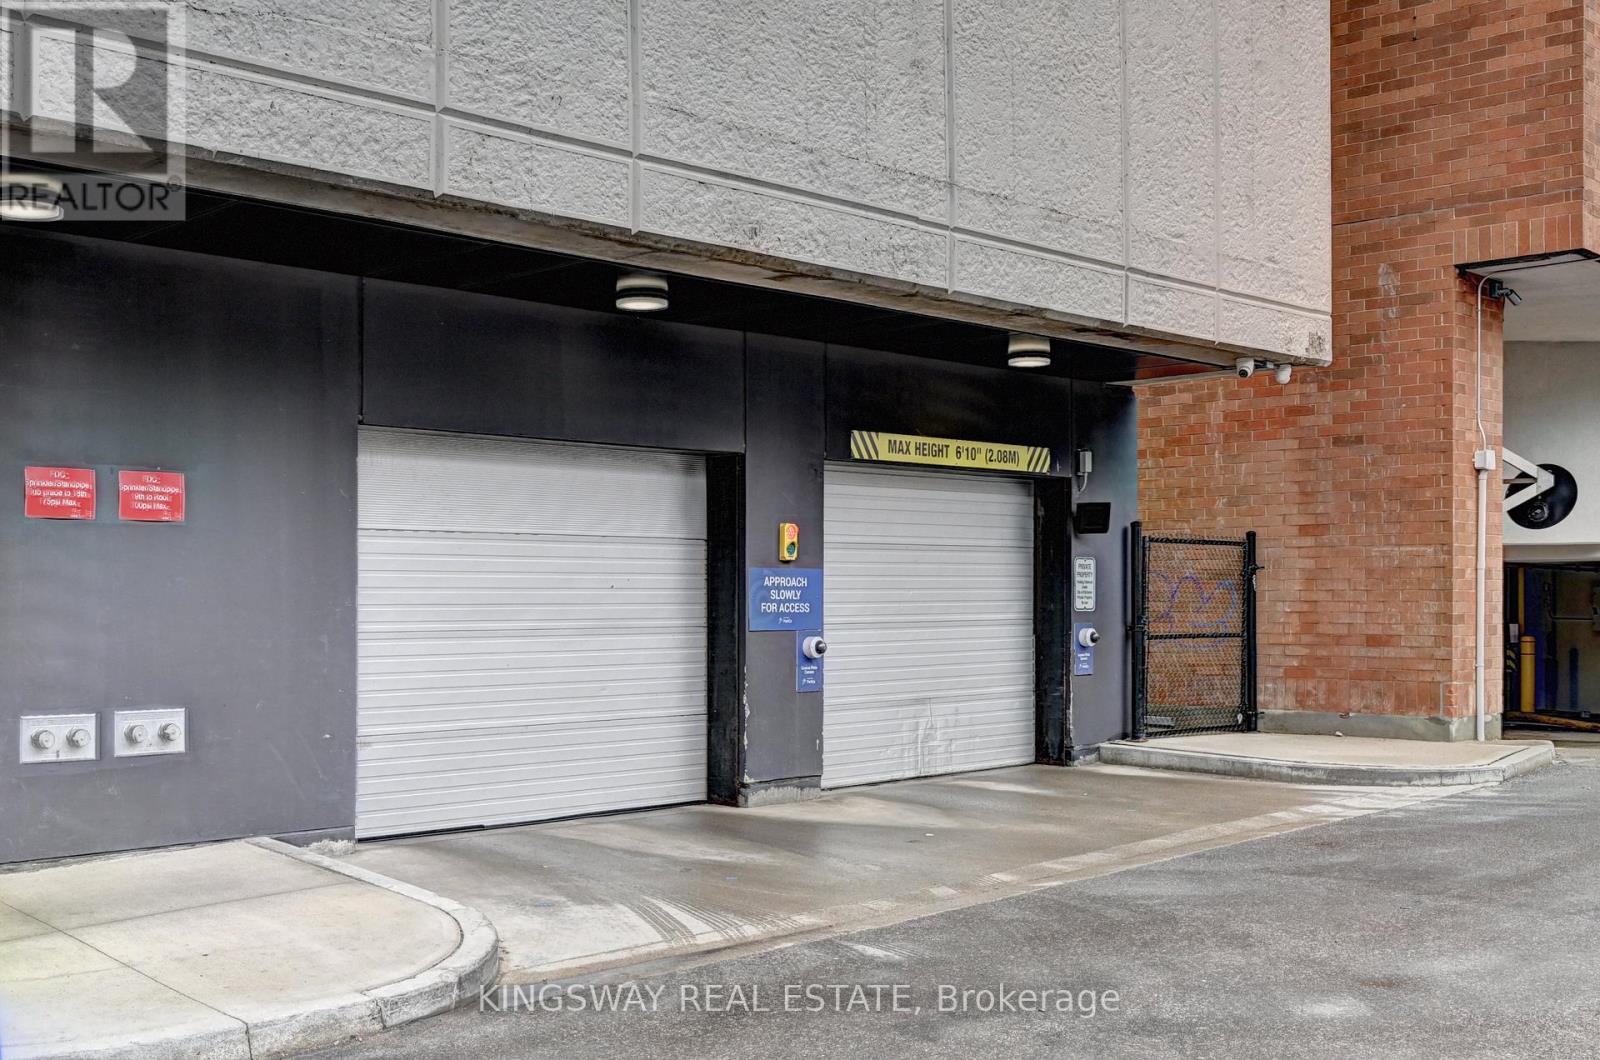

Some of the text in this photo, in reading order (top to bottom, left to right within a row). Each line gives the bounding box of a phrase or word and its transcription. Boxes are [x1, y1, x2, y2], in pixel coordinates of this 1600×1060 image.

[887, 439, 912, 455] MAX
[914, 442, 950, 459] HEIGHT
[985, 448, 1020, 467] (2.08M)
[763, 576, 808, 587] APPROACH
[770, 590, 802, 600] SLOWLY
[761, 603, 810, 613] FOR ACCESS
